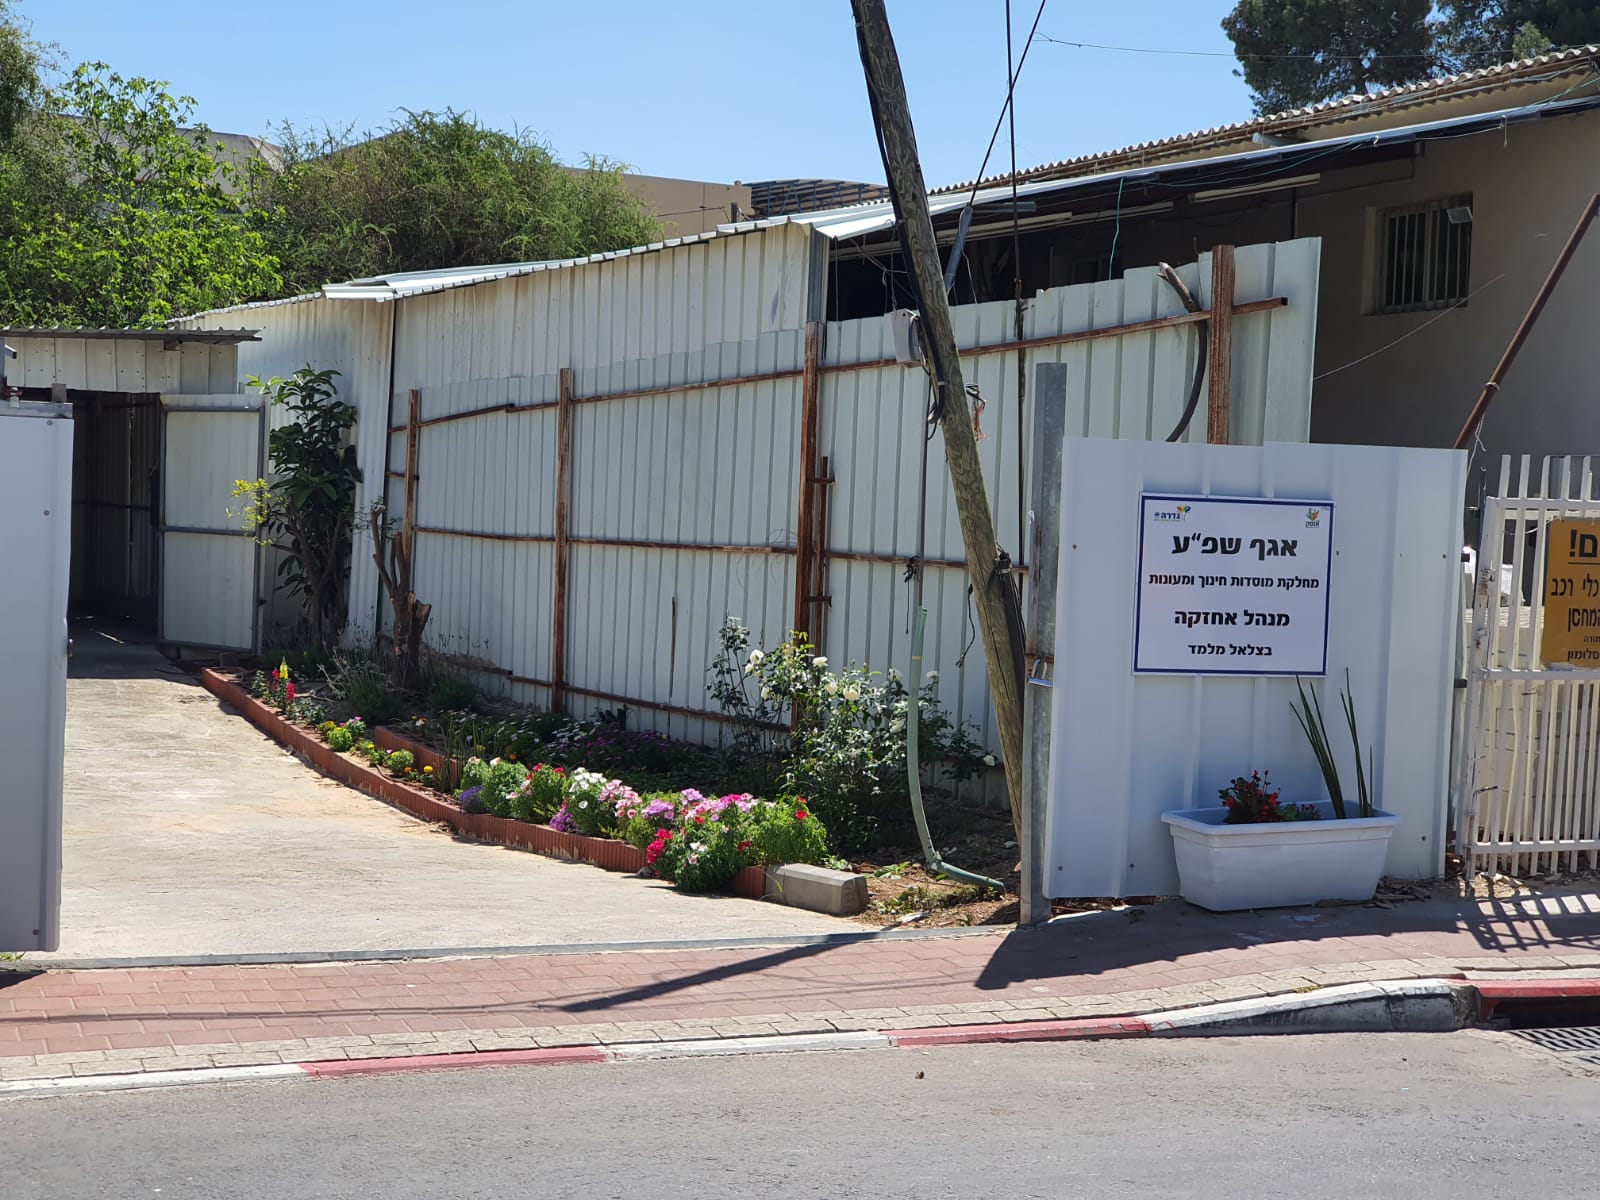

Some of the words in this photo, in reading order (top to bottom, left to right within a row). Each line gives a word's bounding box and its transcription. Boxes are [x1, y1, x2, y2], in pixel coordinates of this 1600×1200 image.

[1250, 539, 1298, 560] אגף
[1148, 574, 1195, 585] ומעונות
[1199, 576, 1227, 588] חינוך
[1230, 577, 1273, 587] מוסדות
[1277, 576, 1319, 590] מחלקת
[1551, 578, 1573, 596] רכב
[1175, 611, 1237, 628] אחזקה
[1244, 609, 1290, 626] מנהל
[1188, 643, 1225, 655] מלמד
[1229, 643, 1272, 656] בצלאל
[1567, 648, 1600, 661] סלומון
